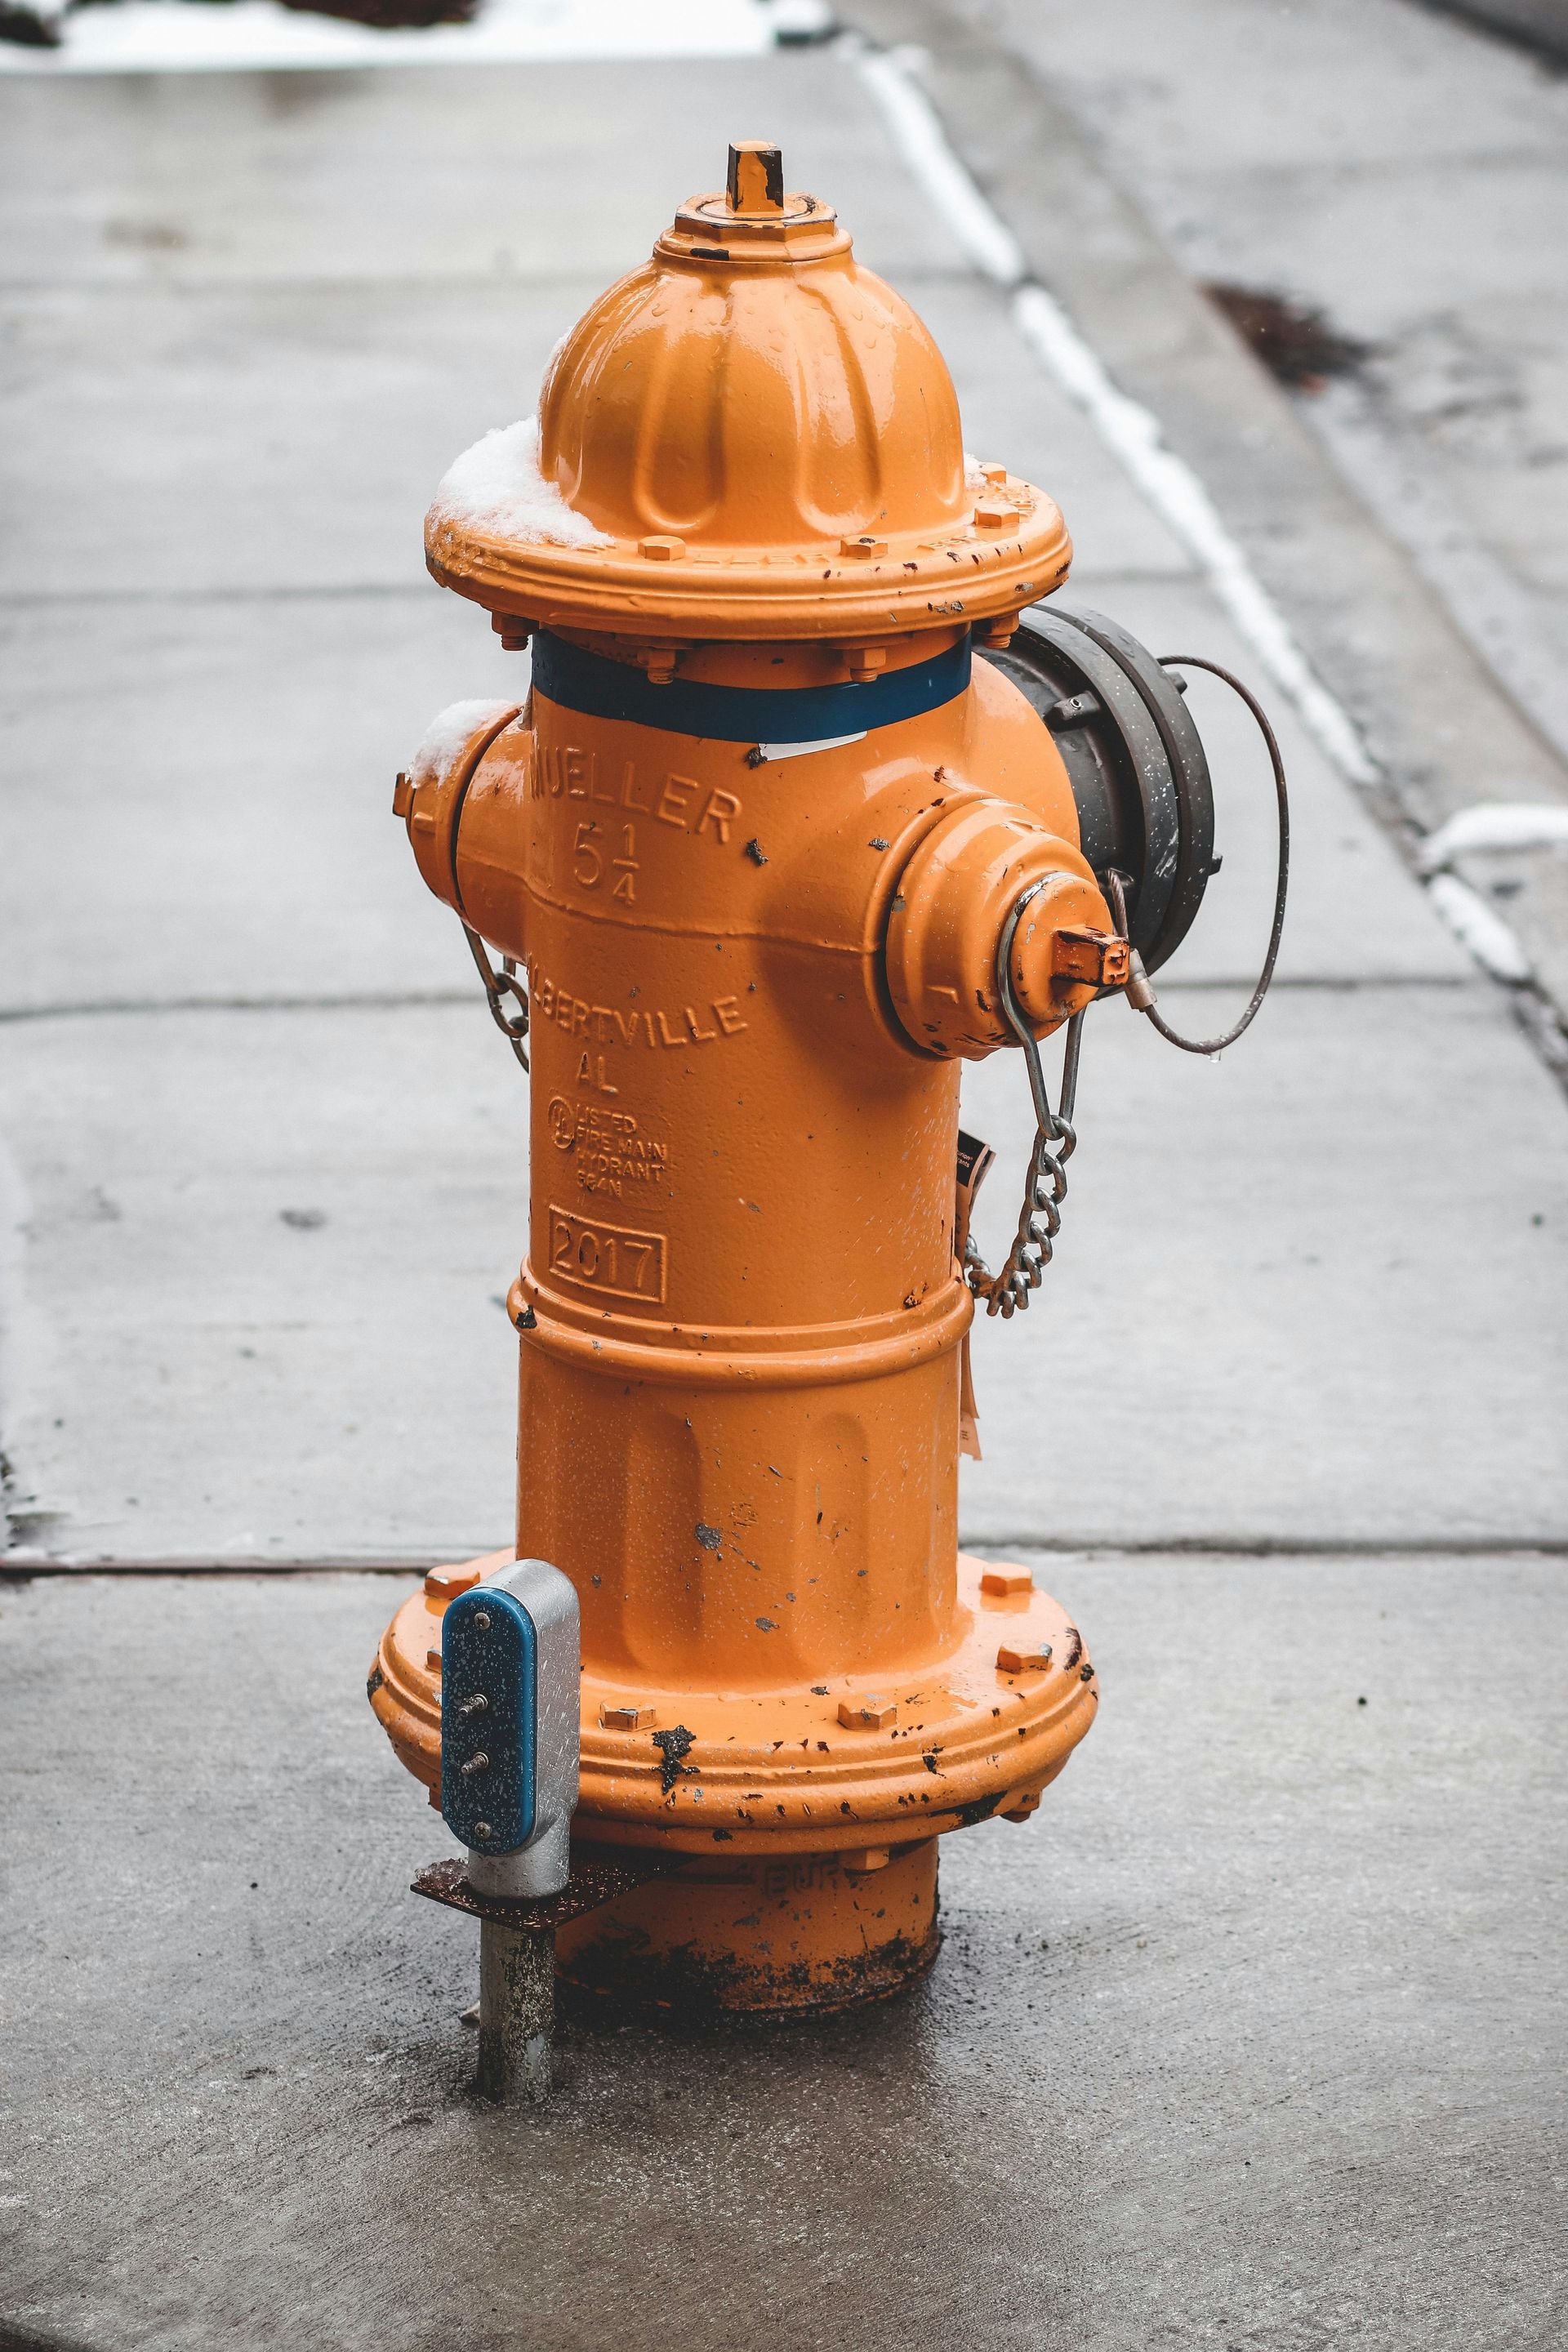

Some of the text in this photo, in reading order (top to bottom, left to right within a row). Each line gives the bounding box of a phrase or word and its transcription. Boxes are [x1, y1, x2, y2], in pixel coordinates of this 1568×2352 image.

[573, 822, 604, 886] 5
[577, 1052, 618, 1094] AL
[618, 1138, 668, 1162] MAIN
[555, 1221, 653, 1288] 2017
